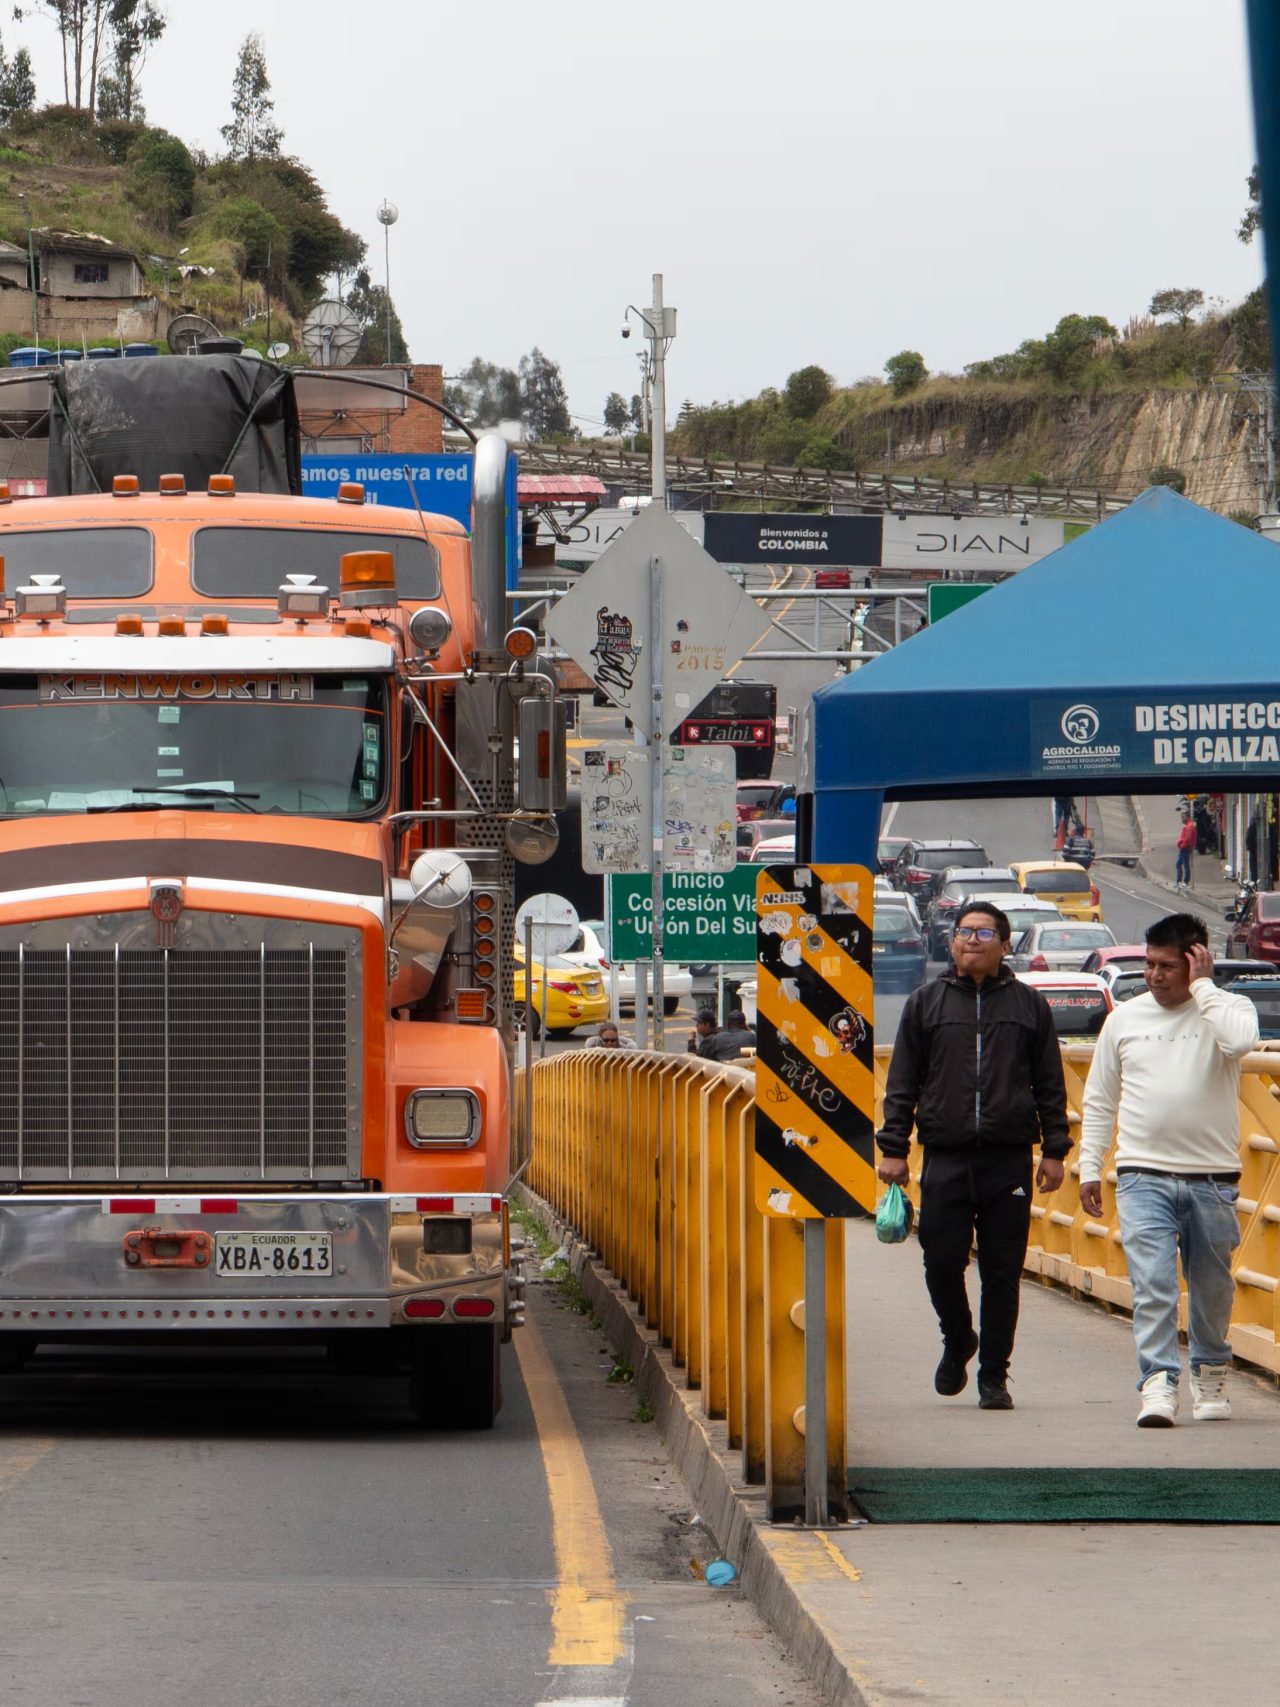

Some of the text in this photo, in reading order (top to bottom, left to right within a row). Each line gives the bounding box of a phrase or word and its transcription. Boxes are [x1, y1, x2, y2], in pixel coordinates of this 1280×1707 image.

[356, 465, 431, 481] nuestra
[436, 464, 468, 481] red
[760, 528, 820, 538] Bienvenidos
[758, 539, 829, 550] COLOMBIA
[916, 533, 1030, 554] DIAN
[38, 673, 315, 700] KENWORTH
[1043, 745, 1121, 756] AGROCALIDAD
[1154, 738, 1188, 764] DE
[672, 872, 725, 889] Inicio
[628, 892, 727, 912] Cocesión
[634, 916, 689, 935] Unón
[696, 916, 726, 935] Del
[252, 1235, 296, 1245] ECUADOR
[219, 1247, 330, 1271] XBA-8613
